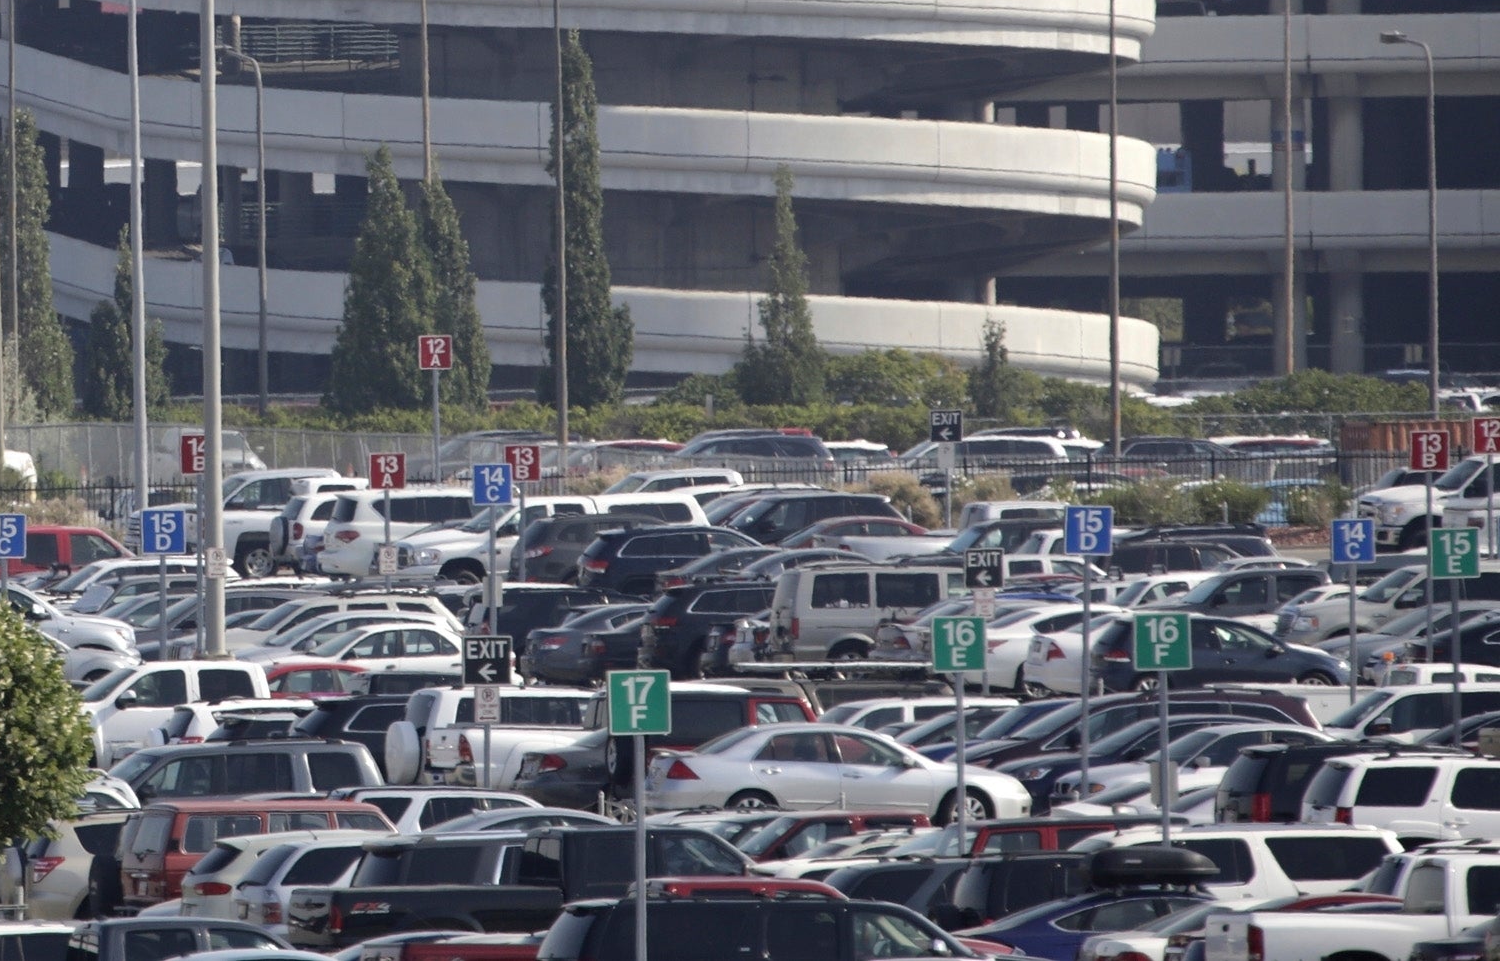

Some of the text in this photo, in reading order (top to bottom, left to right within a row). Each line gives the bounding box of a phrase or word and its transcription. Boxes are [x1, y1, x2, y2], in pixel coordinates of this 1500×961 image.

[426, 337, 446, 355] 12
[430, 354, 442, 367] A
[932, 412, 960, 426] EXIT
[1480, 421, 1500, 437] 12
[1417, 433, 1442, 454] 13
[1485, 438, 1497, 452] A
[376, 457, 399, 475] 13
[511, 447, 534, 466] 13
[1422, 453, 1438, 468] B
[381, 473, 394, 487] A
[479, 466, 506, 486] 14
[514, 463, 531, 478] B
[485, 485, 500, 503] C
[150, 512, 177, 534] 15
[1074, 508, 1103, 534] 15
[155, 533, 172, 551] D
[1078, 531, 1098, 551] D
[1339, 521, 1366, 544] 14
[1344, 541, 1361, 560] C
[1439, 531, 1471, 561] 15
[967, 552, 1000, 568] EXIT
[1447, 558, 1462, 574] E
[941, 619, 976, 648] 16
[1144, 615, 1180, 645] 16
[466, 640, 507, 659] EXIT
[950, 645, 967, 668] E
[1154, 642, 1170, 665] F
[620, 674, 656, 706] 17
[630, 703, 648, 729] F
